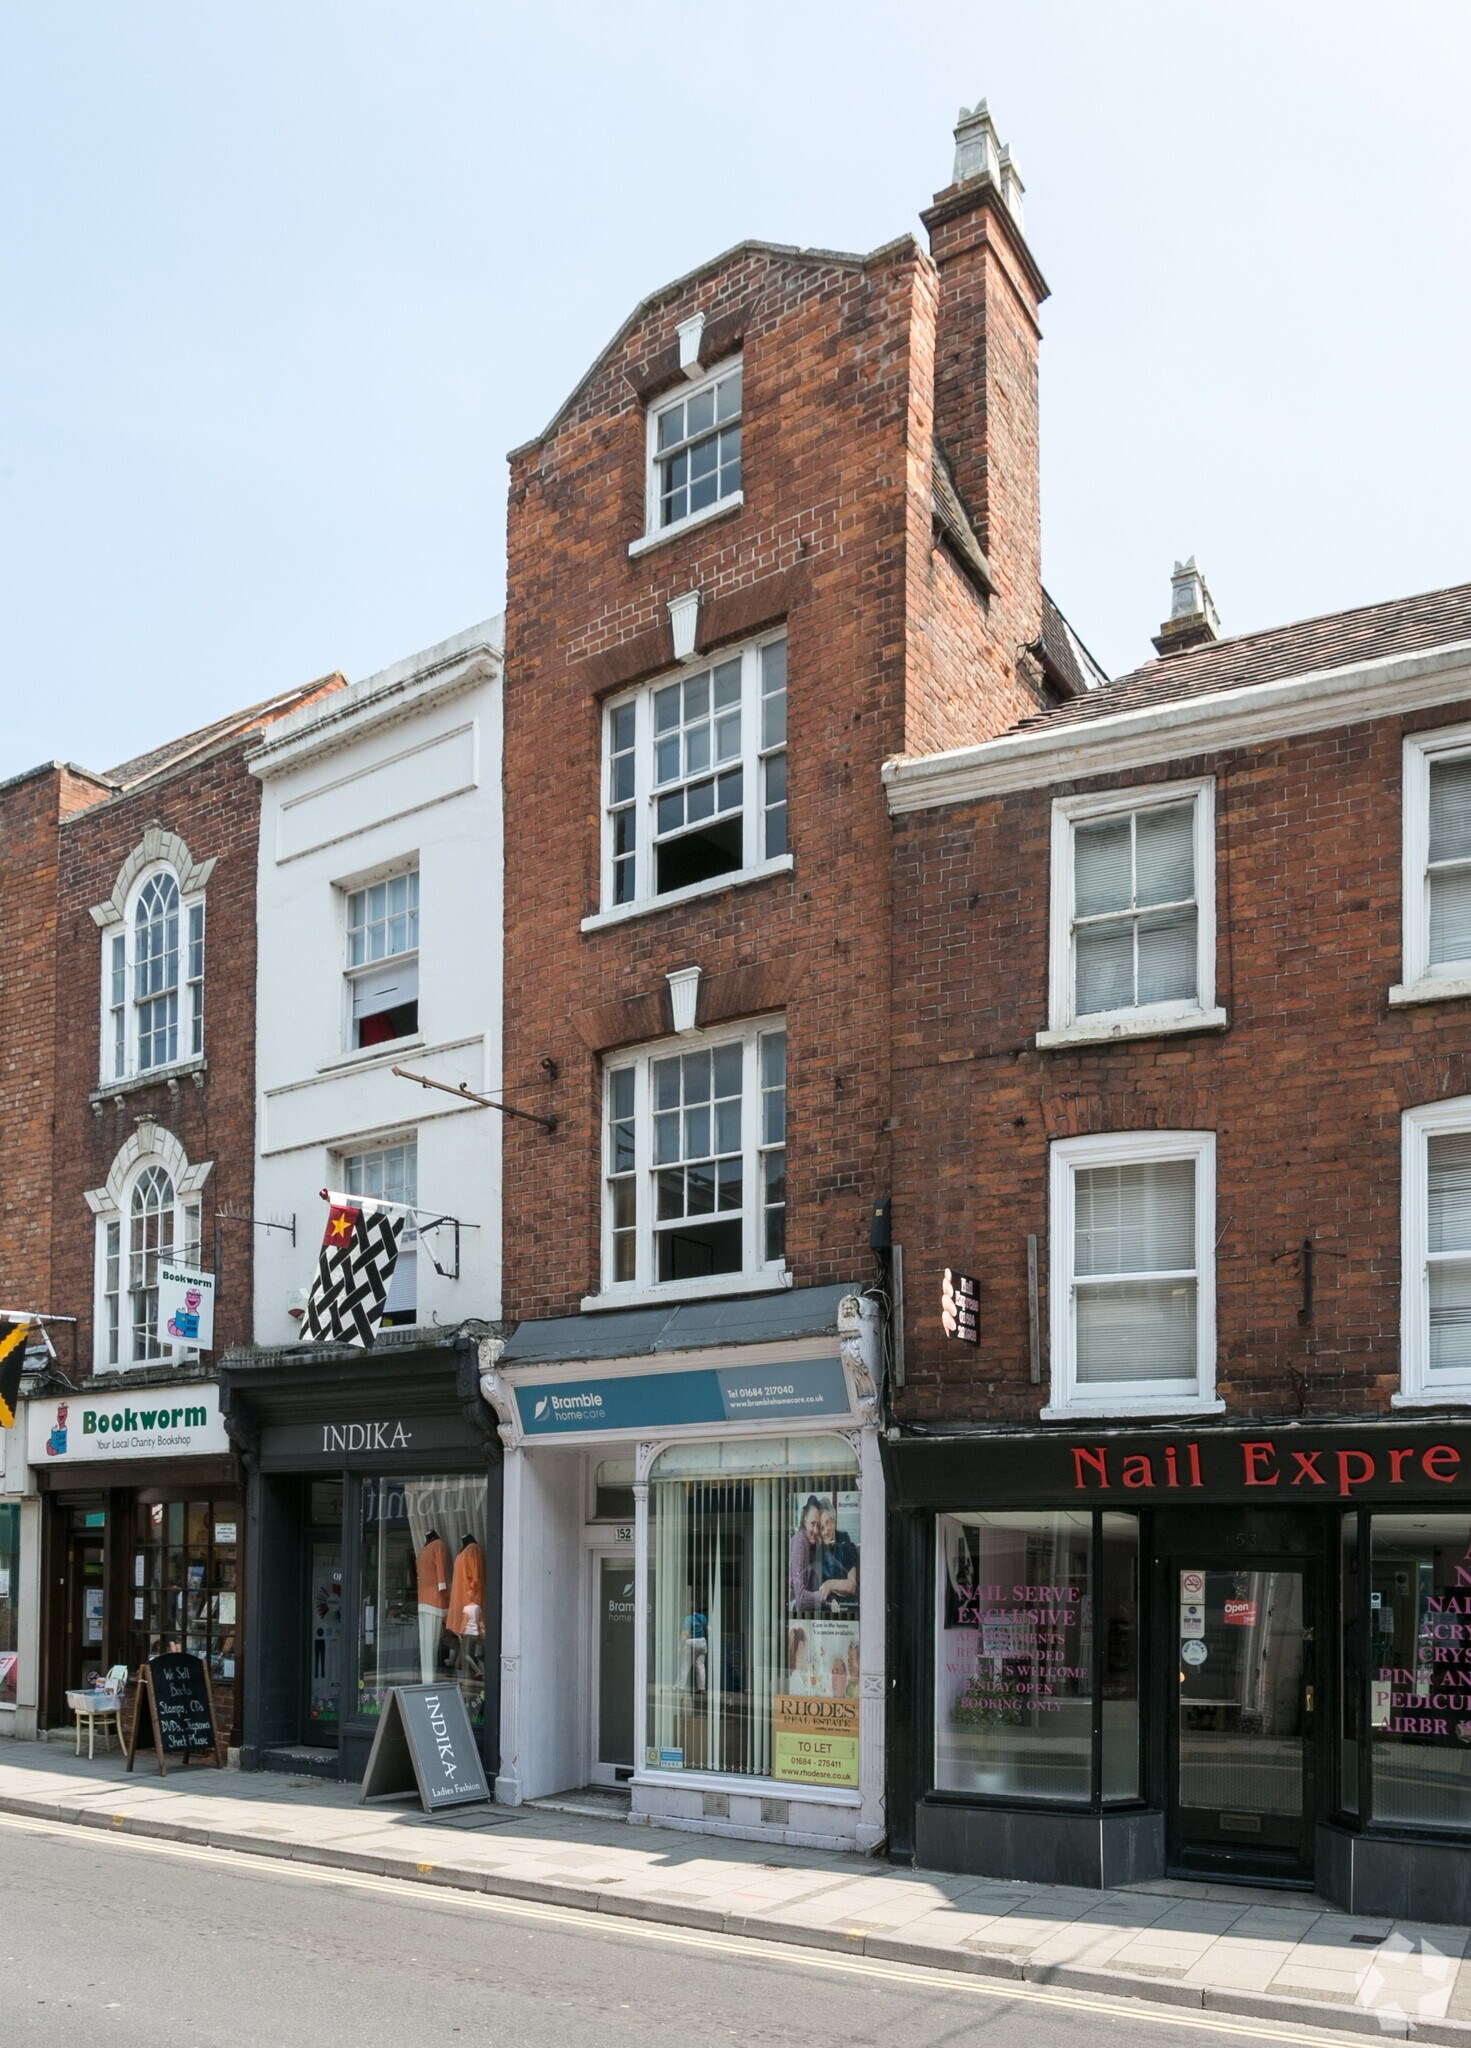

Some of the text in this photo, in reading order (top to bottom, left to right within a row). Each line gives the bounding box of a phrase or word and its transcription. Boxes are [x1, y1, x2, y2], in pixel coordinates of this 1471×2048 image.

[163, 1271, 212, 1288] Bookworm
[727, 1385, 794, 1398] Tel 01684 217040
[551, 1393, 603, 1409] Bramble
[730, 1394, 824, 1408] www.bramblehomecare.co.uk
[83, 1405, 207, 1434] Bookworm
[555, 1409, 606, 1421] homecare
[97, 1435, 191, 1449] Your Local Charity Bookshop
[322, 1421, 412, 1451] INDIKA
[1070, 1441, 1462, 1497] Nail Expre
[616, 1528, 631, 1539] 152
[956, 1585, 1081, 1603] NAIL SERVE
[609, 1600, 652, 1612] Brame
[1225, 1603, 1249, 1614] Open
[957, 1607, 1077, 1627] EXCLUSIVE
[957, 1631, 1066, 1645] APPOINMENTS
[176, 1666, 190, 1679] Sell
[1017, 1665, 1089, 1679] WELCOME
[1378, 1668, 1434, 1685] PINK
[1016, 1682, 1054, 1695] OPEN
[190, 1700, 205, 1712] CDs
[780, 1700, 856, 1719] RHODES
[960, 1697, 1064, 1712] BOOKING ONLY
[784, 1715, 851, 1728] REAL ESTATE
[168, 1733, 208, 1748] Sheet Music
[424, 1695, 458, 1780] INDIKA
[798, 1741, 832, 1754] TO LET
[791, 1757, 811, 1765] 01684
[818, 1760, 841, 1768] 275411
[781, 1768, 852, 1780] www.rhodesre.co.uk
[432, 1782, 480, 1797] Ladies Fashion
